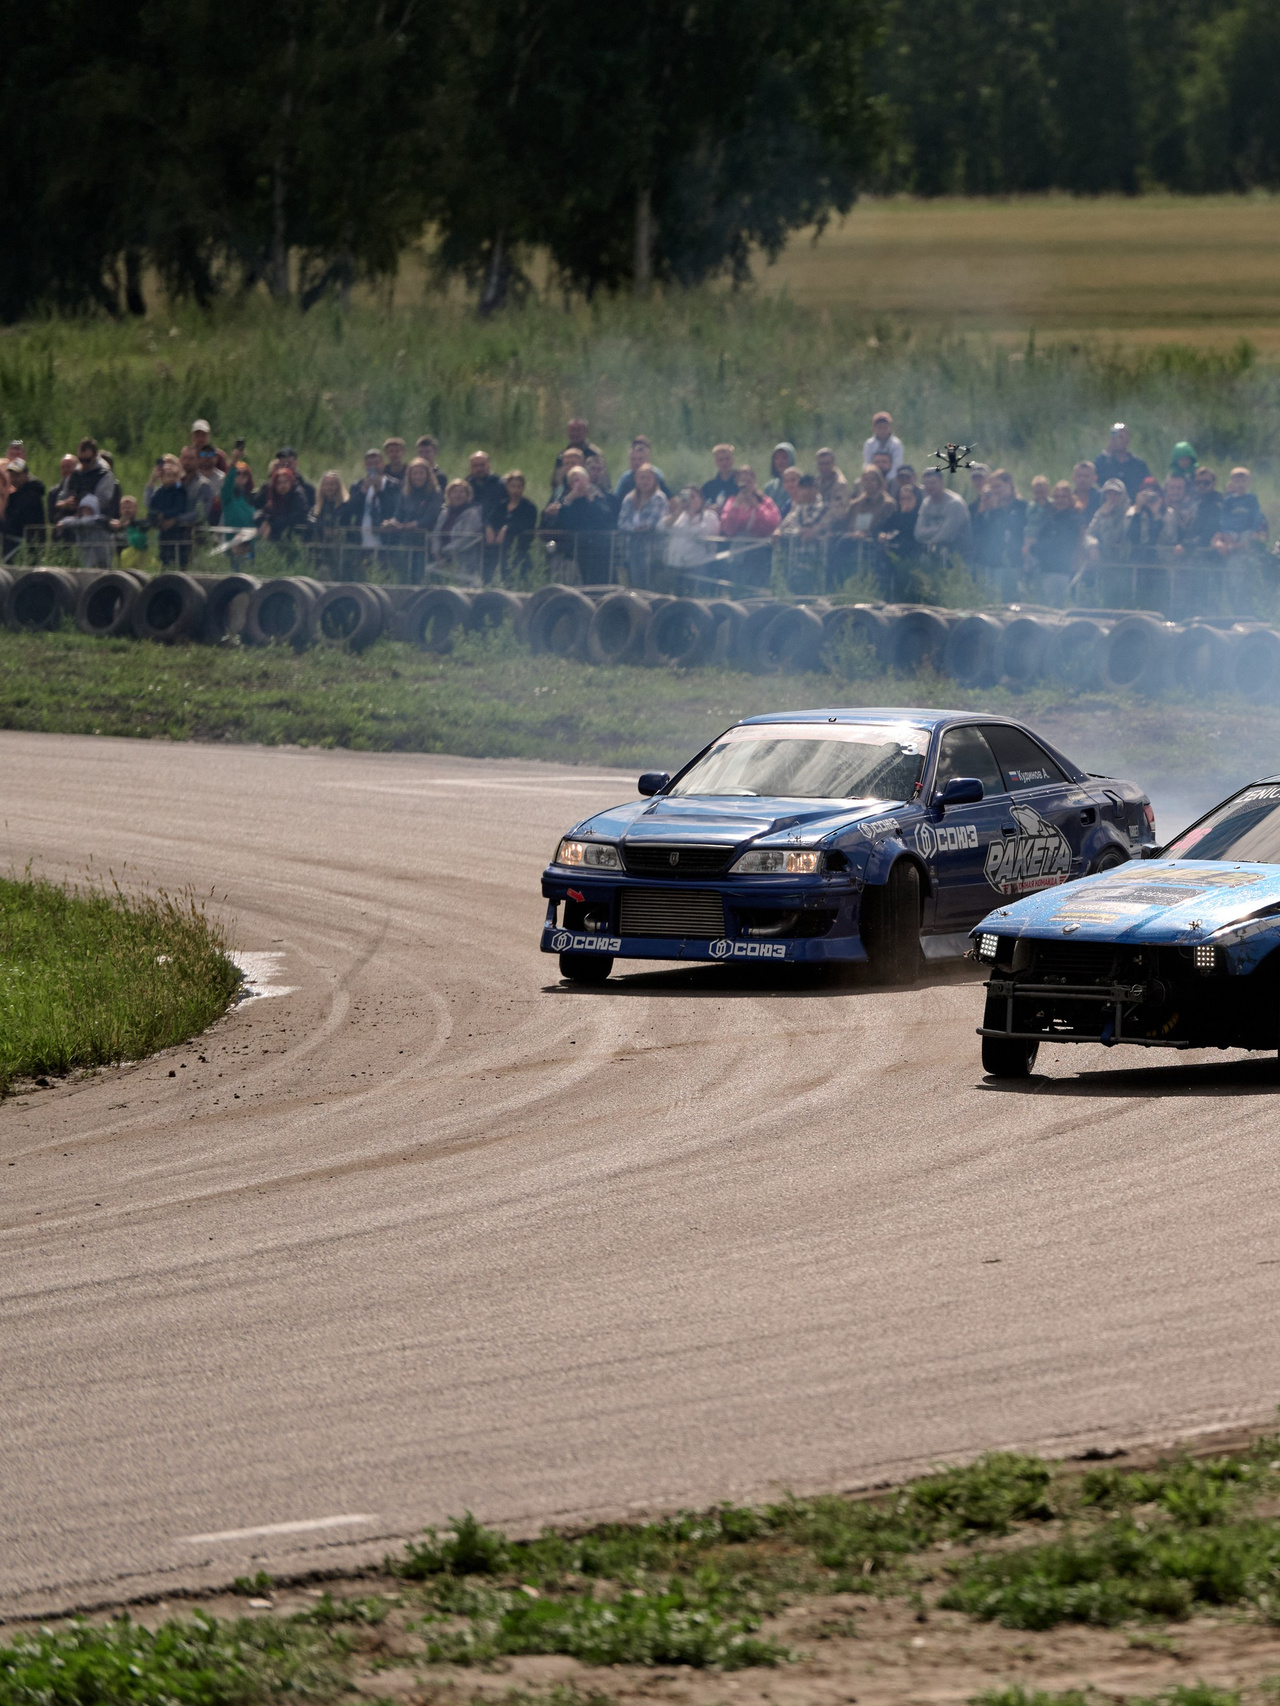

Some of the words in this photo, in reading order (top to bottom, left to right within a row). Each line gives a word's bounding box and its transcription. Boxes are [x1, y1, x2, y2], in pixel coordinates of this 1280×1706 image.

[1017, 769, 1043, 783] Кудинов
[870, 817, 900, 834] СОЮЗ
[936, 824, 979, 852] СОЮЗ
[986, 836, 1070, 882] РАКЕТА
[573, 936, 622, 951] СОЮЗ
[734, 942, 786, 958] СОЮЗ
